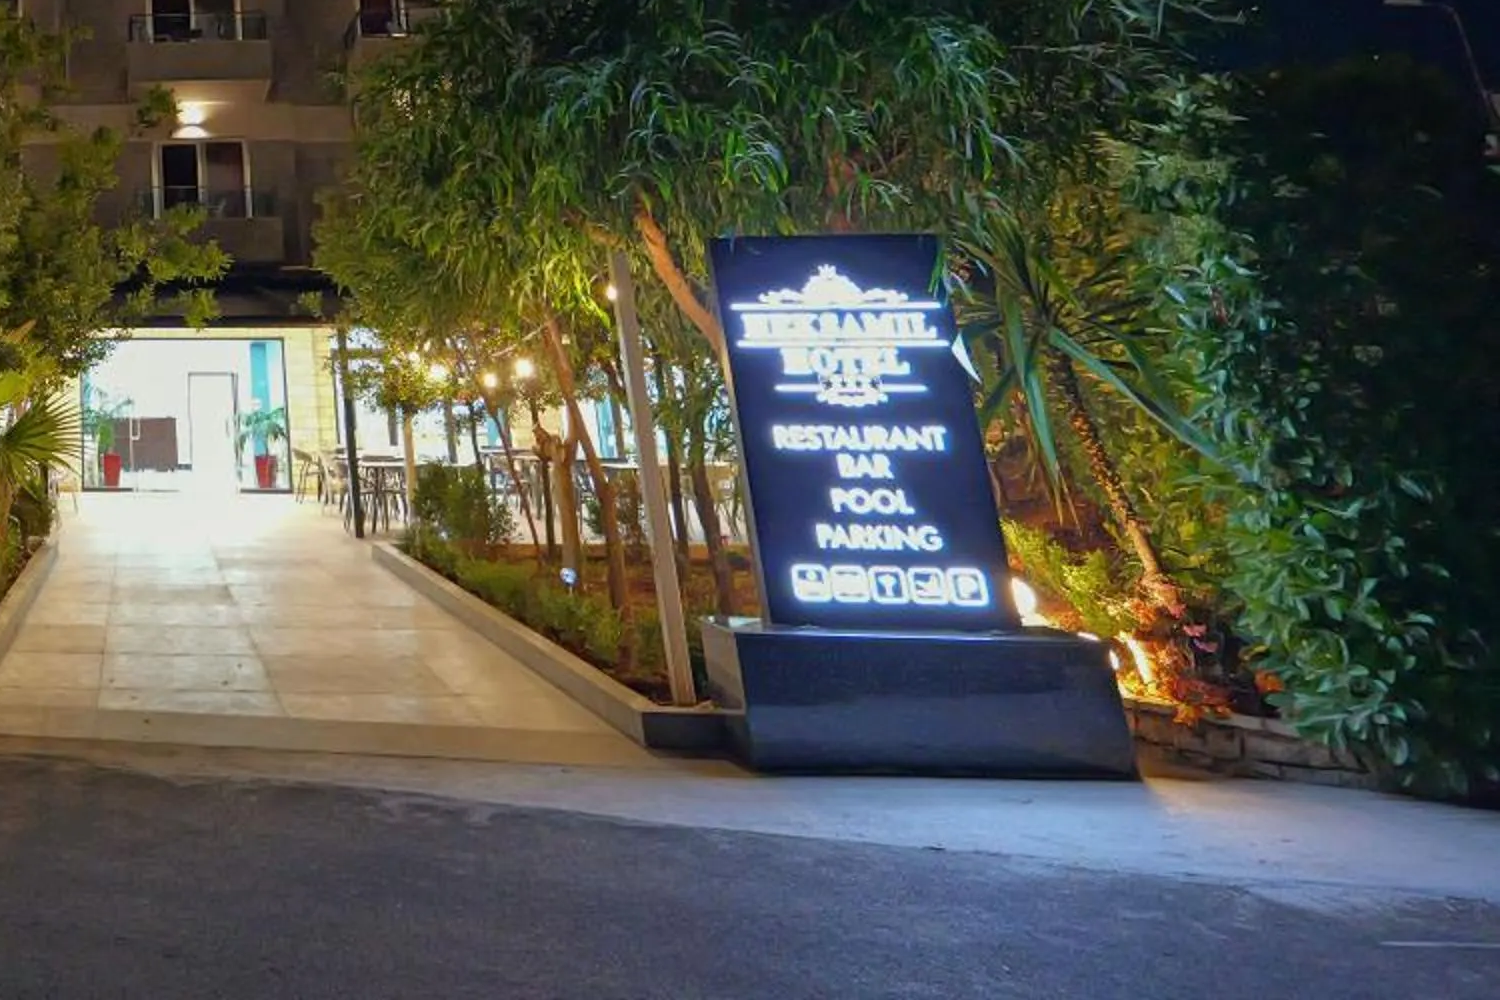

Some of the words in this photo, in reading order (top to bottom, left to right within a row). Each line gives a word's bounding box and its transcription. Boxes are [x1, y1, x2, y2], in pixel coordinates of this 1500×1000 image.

[781, 347, 911, 375] HOTEL
[772, 424, 947, 451] RESTAURANT
[836, 453, 894, 479] BAR
[829, 487, 915, 515] POOL
[815, 523, 943, 552] PARKING
